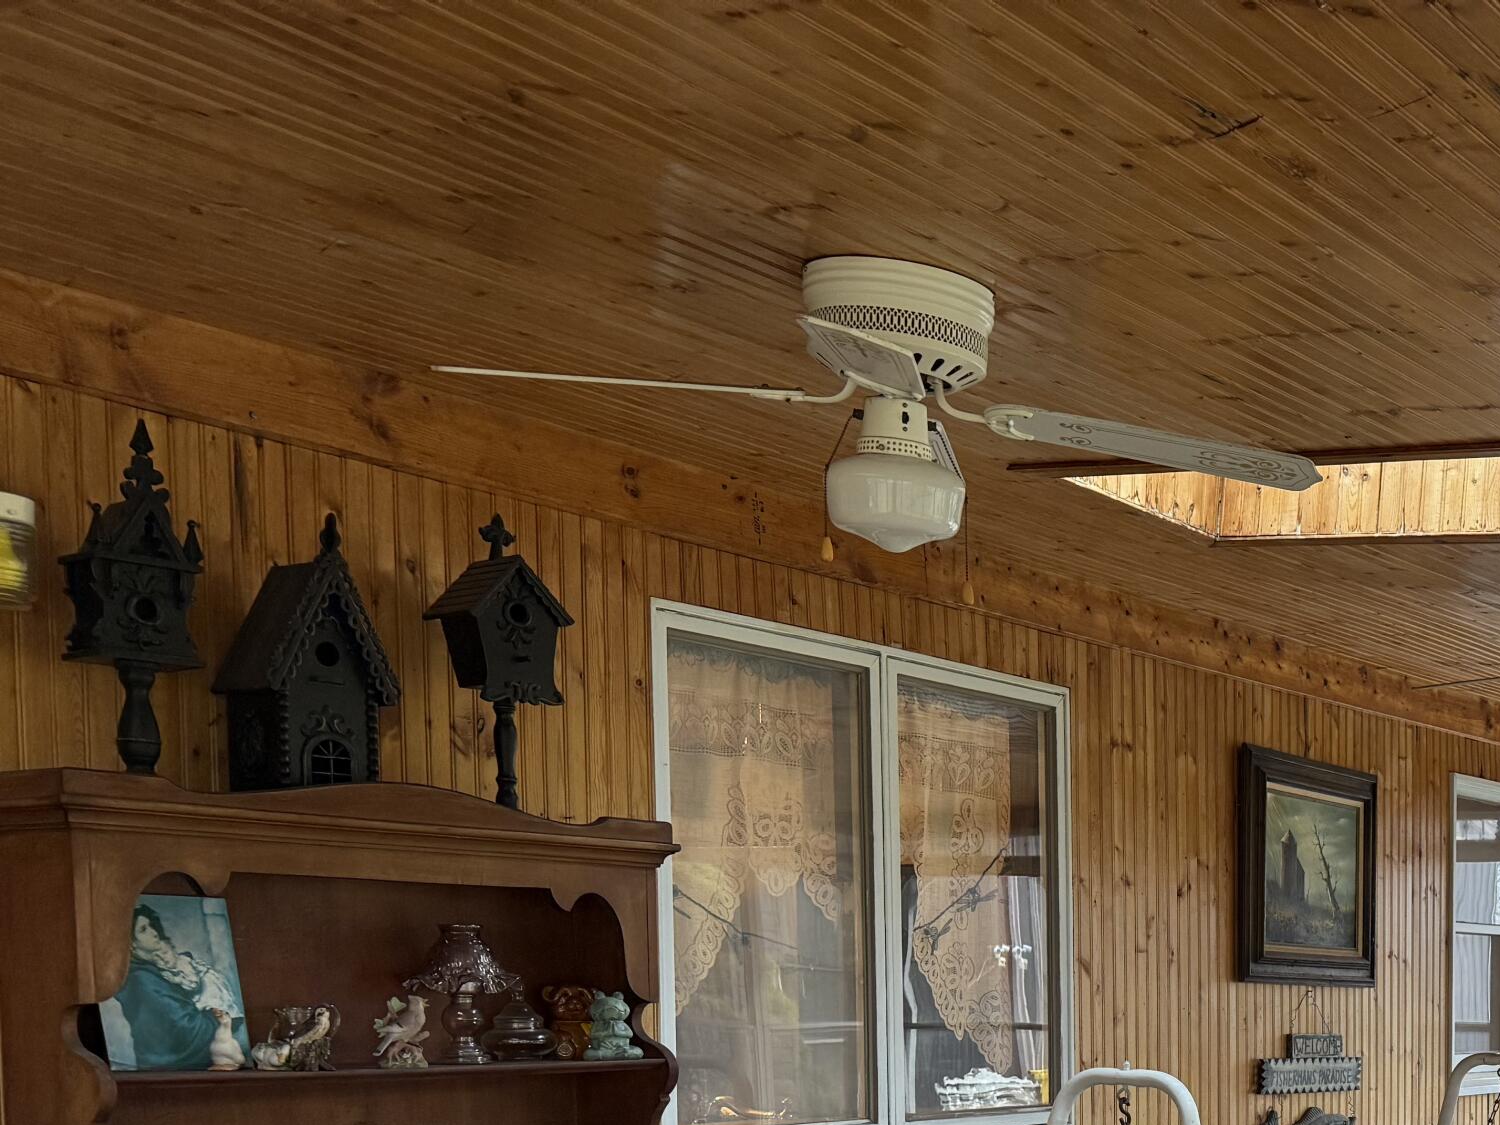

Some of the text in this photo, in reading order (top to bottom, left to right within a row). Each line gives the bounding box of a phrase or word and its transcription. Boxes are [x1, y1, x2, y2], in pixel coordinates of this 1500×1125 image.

[1294, 1038, 1343, 1055] WELCOME
[1272, 1068, 1353, 1087] FISHERMANS PARADISE
